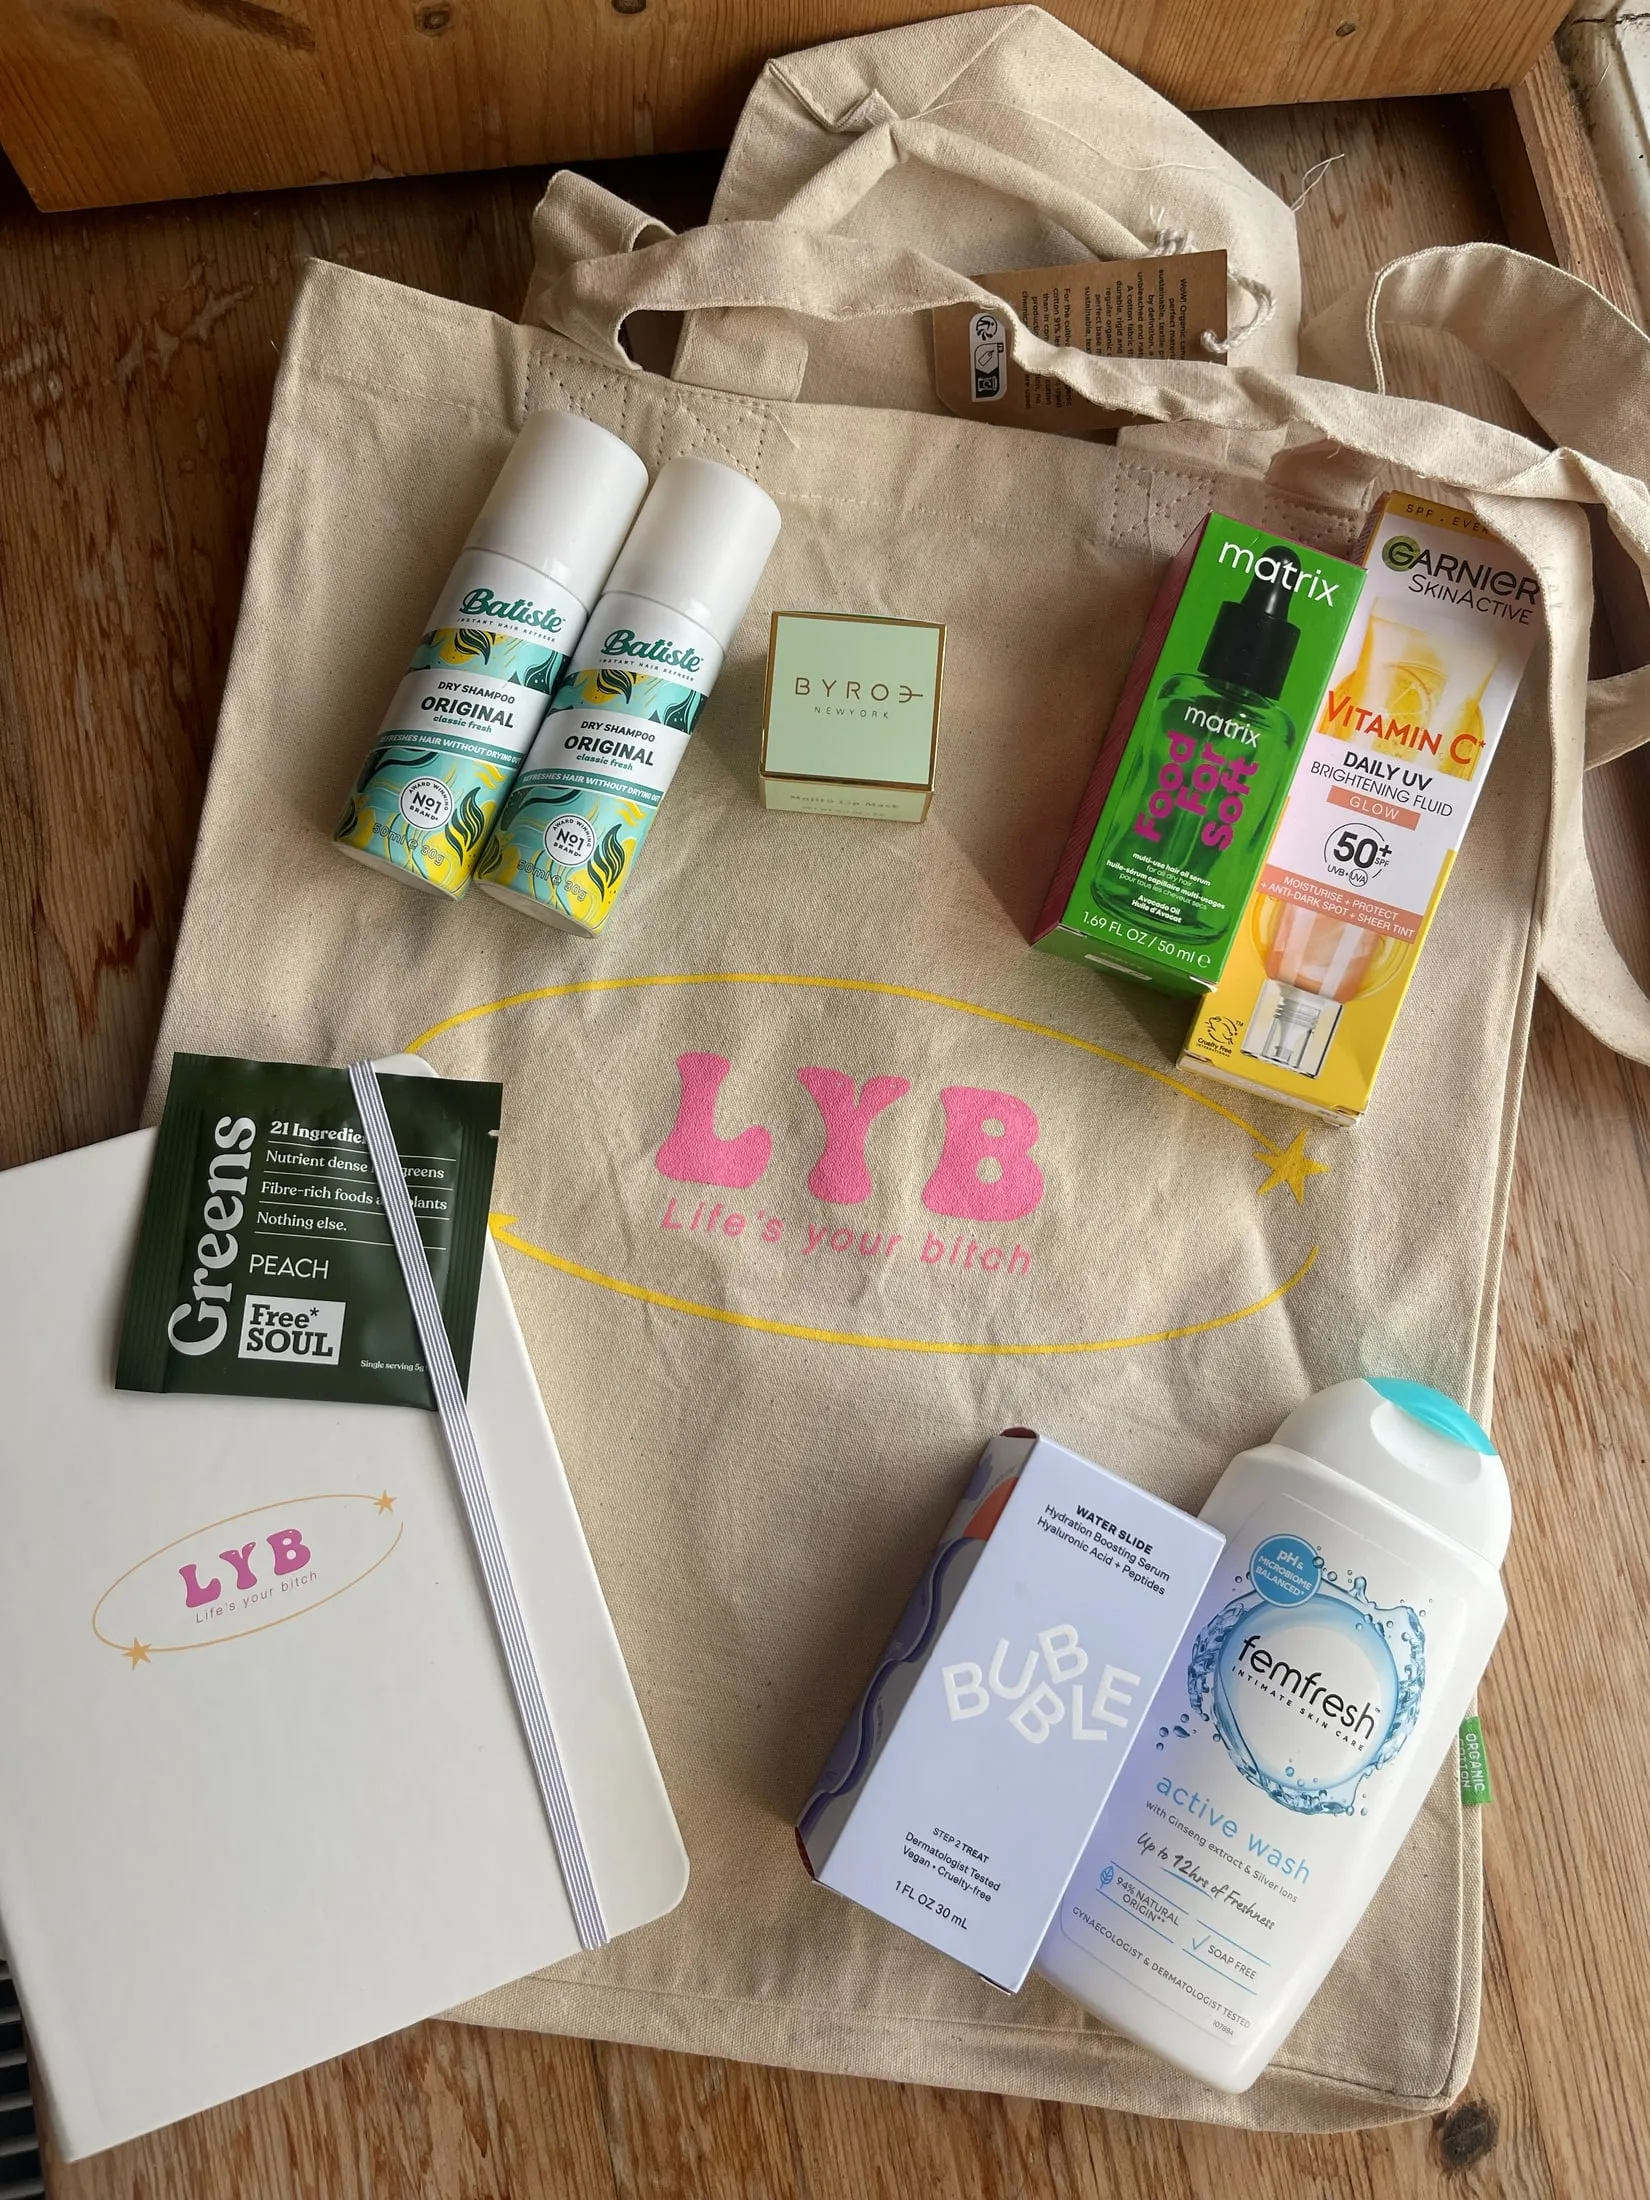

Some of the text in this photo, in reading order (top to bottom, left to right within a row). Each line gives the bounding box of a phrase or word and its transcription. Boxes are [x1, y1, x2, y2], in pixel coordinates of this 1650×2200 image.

[1093, 294, 1101, 323] perfect
[1104, 287, 1112, 316] regular
[1136, 272, 1144, 321] unbleached
[1146, 294, 1154, 304] by
[1167, 298, 1176, 327] perfect
[1043, 314, 1049, 322] in
[1115, 317, 1123, 336] rigid
[1178, 305, 1187, 337] Organic
[1406, 504, 1433, 518] SPF
[1218, 542, 1339, 607] matrix
[459, 589, 562, 633] Batiste
[600, 629, 702, 673] Batiste
[438, 681, 515, 704] DRY SHAMPOO
[420, 696, 516, 728] ORIGINAL
[433, 714, 492, 732] classic fresh
[1184, 706, 1260, 748] matrix
[1320, 690, 1442, 755] VITAMIN
[419, 734, 441, 745] HAIR
[442, 738, 486, 755] WITHOUT
[580, 721, 655, 743] DRY SHAMPOO
[564, 736, 656, 766] ORIGINAL
[576, 753, 632, 770] classic fresh
[561, 771, 585, 783] HAIR
[584, 776, 627, 792] WITHOUT
[1133, 730, 1197, 843] Food
[1175, 742, 1225, 816] For
[1310, 761, 1452, 816] BRIGHTENING FLUID
[1343, 751, 1432, 791] DAILY UV
[1201, 757, 1259, 851] Soft
[1350, 796, 1400, 820] GLOW
[1132, 853, 1210, 886] multi-use hair oil serum
[1374, 856, 1389, 867] SPF
[1147, 875, 1180, 892] capillaire
[1166, 874, 1192, 886] dry hair
[1284, 876, 1398, 920] MOISTURISE PROTECT
[1131, 899, 1181, 923] Huile d'Avocat
[1136, 894, 1181, 915] Avocado Oil
[1268, 883, 1415, 938] ANTI-DARK SPOT SHEER TINT
[1083, 911, 1195, 963] 1.69 FL OZ 50 ml
[270, 1120, 289, 1135] 21
[655, 1052, 1044, 1221] LYB
[266, 1150, 368, 1172] Nutrient dense
[261, 1181, 373, 1204] Fibre-rich foods
[167, 1116, 256, 1356] Greens
[256, 1211, 347, 1231] Nothing else.
[660, 1197, 1031, 1274] Life's your bitch
[249, 1254, 329, 1279] PEACH
[246, 1327, 333, 1357] SOUL
[360, 1359, 413, 1371] Single serving
[1045, 1504, 1170, 1582] Hydration Boosting Serum
[1076, 1505, 1153, 1555] WATER SLIDE
[179, 1529, 311, 1608] LYB
[1037, 1516, 1165, 1595] Hyaluronic Acid Peptides
[1256, 1554, 1312, 1590] MICROBIOME
[1276, 1550, 1299, 1566] pH
[196, 1571, 317, 1624] Life's your bitch
[1238, 1635, 1374, 1740] femfresh
[1232, 1665, 1364, 1752] INTIMATE SKIN CARE
[1463, 1732, 1486, 1793] ORGANIC
[933, 1828, 990, 1863] STEP 2 TREAT
[1156, 1777, 1310, 1884] active wash
[905, 1832, 1001, 1891] Dermatologist Tested
[1146, 1800, 1298, 1903] with Ginseng extract Silver Ions
[903, 1845, 992, 1902] Vegan Cruelty-free
[1137, 1832, 1275, 1930] Up to 12hrs of Freshness
[896, 1880, 967, 1930] 1 FL OZ 30 mL
[1116, 1876, 1178, 1926] 94% NATURAL
[1072, 1906, 1250, 2028] GYNAECOLOGIST DERMATOLOGIST TESTED
[1208, 1944, 1257, 1980] SOAP FREE
